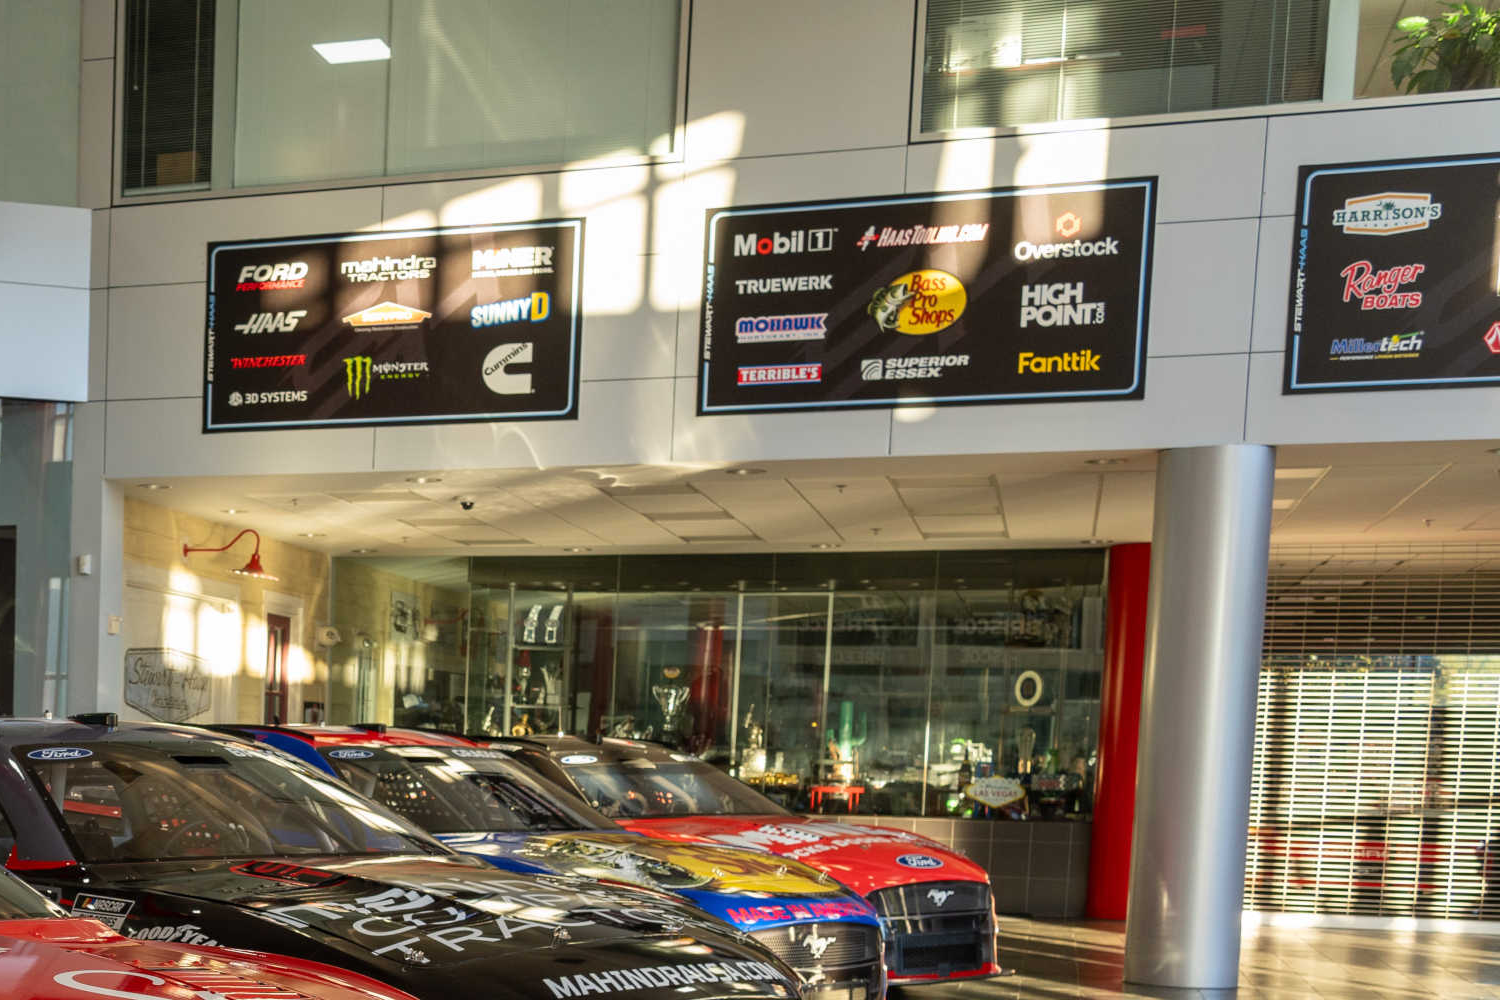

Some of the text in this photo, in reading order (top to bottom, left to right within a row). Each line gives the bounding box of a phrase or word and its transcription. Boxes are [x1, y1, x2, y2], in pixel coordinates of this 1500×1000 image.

[733, 230, 804, 257] Mobil
[1014, 236, 1120, 261] Overstock
[237, 261, 309, 283] FORD
[340, 254, 437, 274] mahindra
[346, 268, 431, 283] TRACTORS
[734, 274, 834, 295] TRUEWERK
[910, 273, 947, 293] Bass
[1340, 259, 1425, 303] Ranger
[909, 291, 938, 309] Pro
[1021, 281, 1084, 307] HIGH
[1361, 291, 1423, 311] BOATS
[234, 310, 308, 334] HAAS
[738, 315, 824, 334] MOHAWK
[908, 307, 956, 328] Shops
[230, 353, 308, 369] WINCHESTER
[372, 361, 429, 374] MONSTER
[483, 342, 529, 377] Cummins
[884, 354, 970, 369] SUPERIOR
[1017, 349, 1102, 375] Fanttik
[739, 366, 819, 382] TERRIBLE'S
[884, 366, 941, 380] ESSEX
[244, 390, 309, 405] 3D SYSTEMS
[42, 748, 82, 760] Ford
[725, 905, 792, 924] MADE
[542, 961, 788, 1000] MAHINDRAUSA.COM
